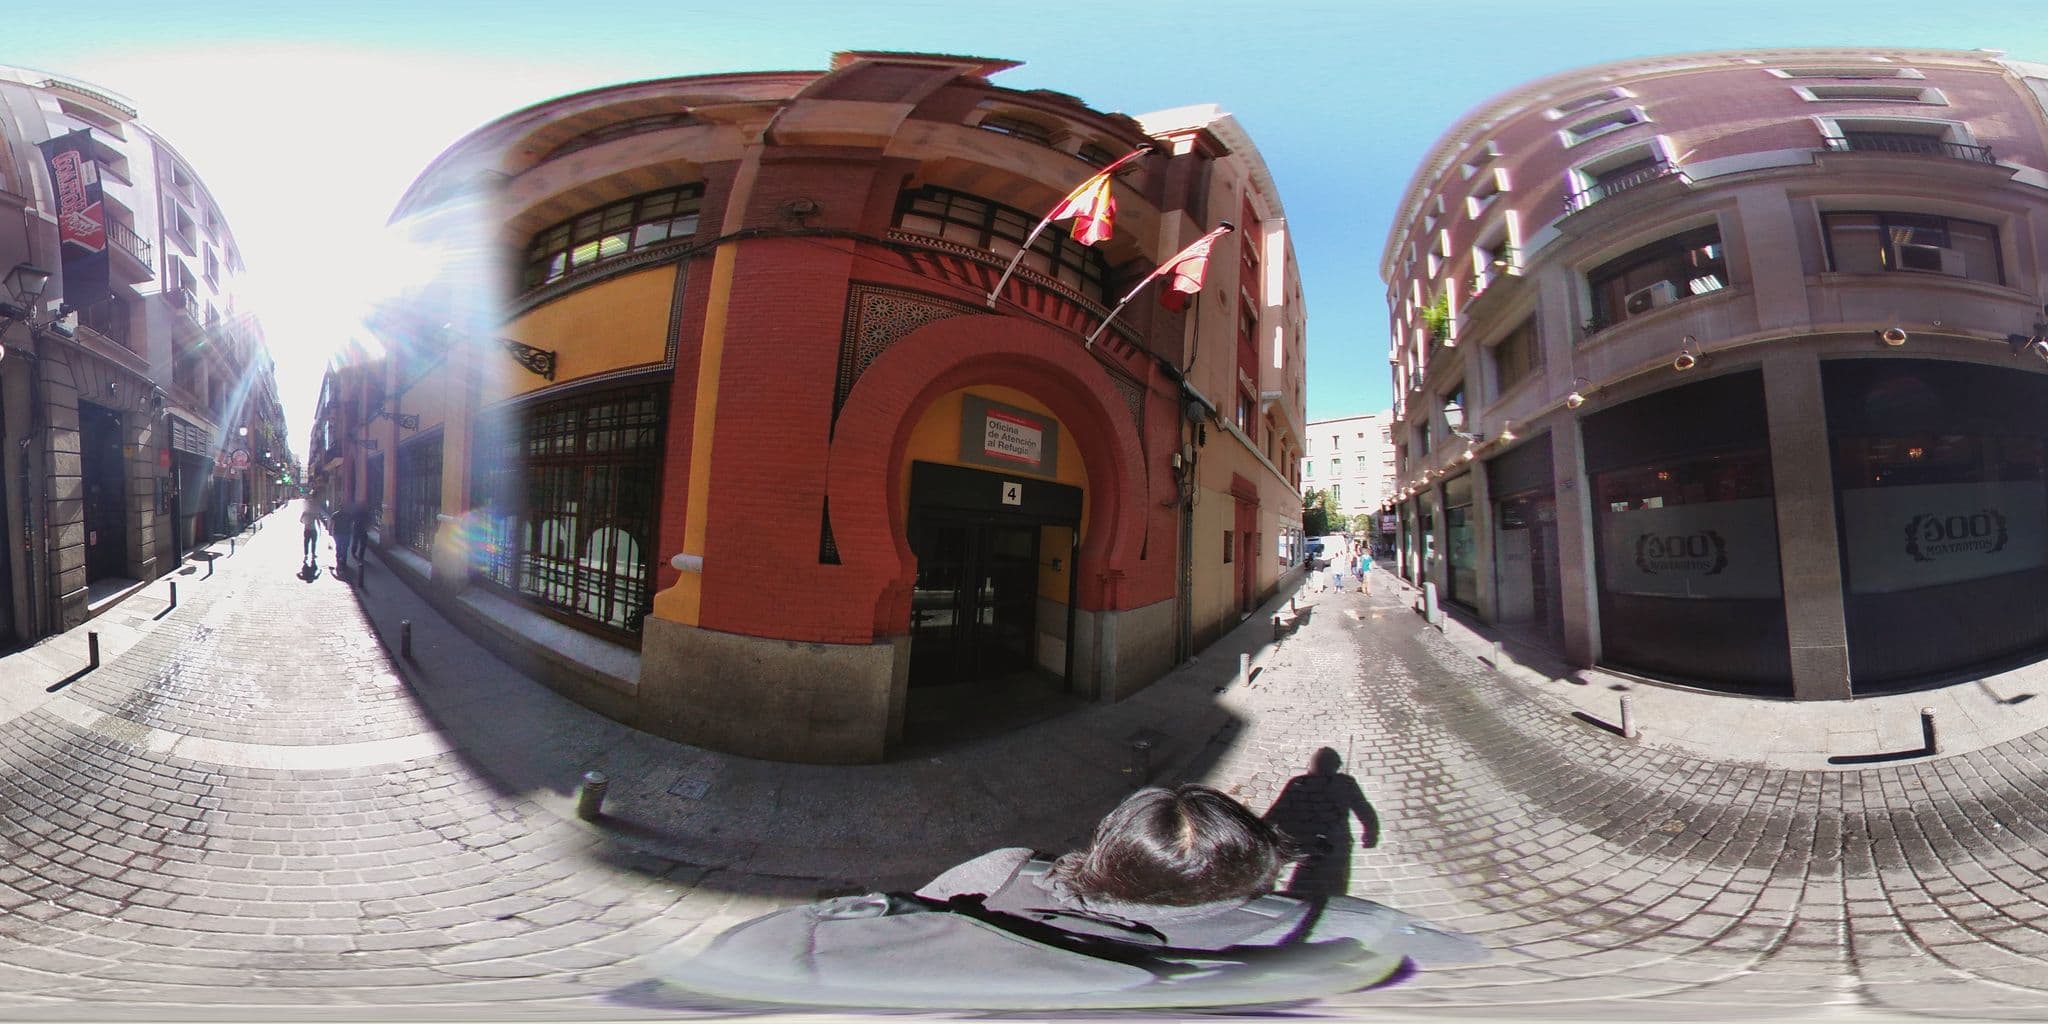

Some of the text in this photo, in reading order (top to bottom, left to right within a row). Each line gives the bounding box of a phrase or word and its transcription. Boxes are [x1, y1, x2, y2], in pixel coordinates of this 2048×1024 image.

[989, 420, 1019, 435] Oficina
[988, 430, 1037, 448] de Atención
[998, 441, 1029, 455] Refugio
[1007, 487, 1017, 501] 4
